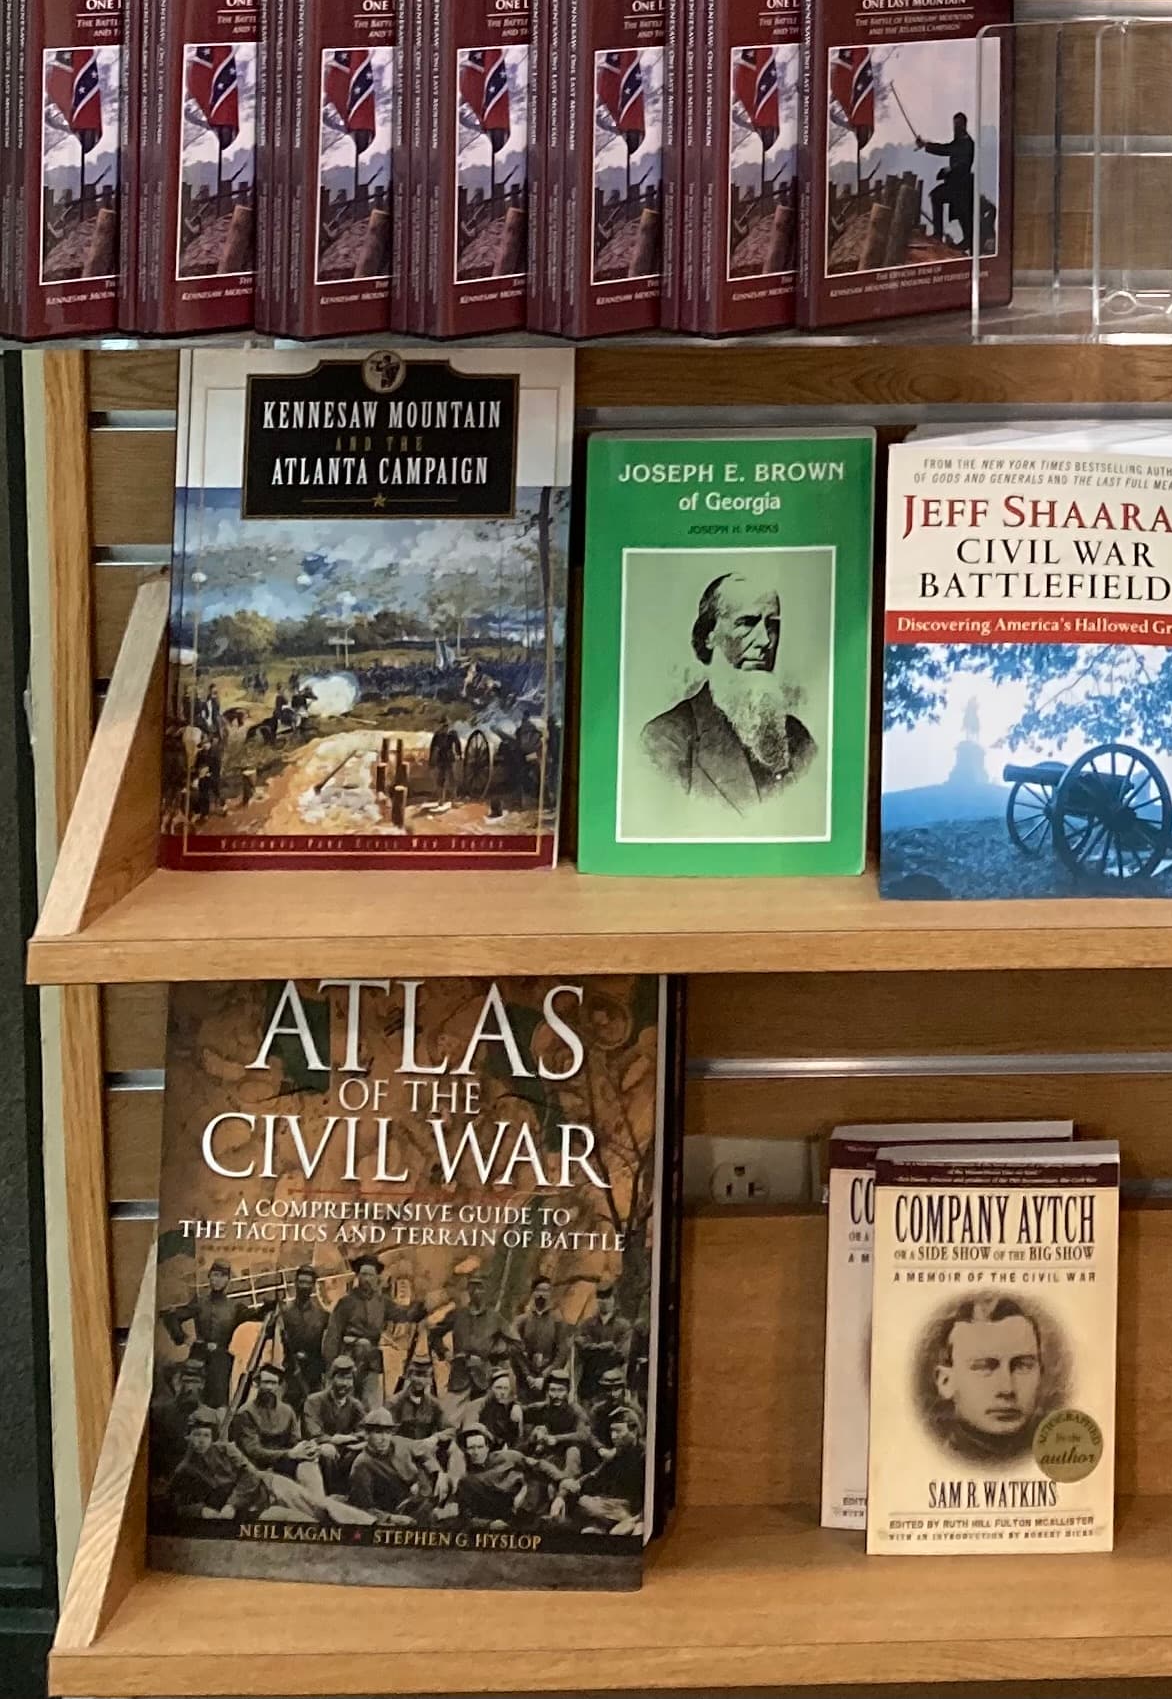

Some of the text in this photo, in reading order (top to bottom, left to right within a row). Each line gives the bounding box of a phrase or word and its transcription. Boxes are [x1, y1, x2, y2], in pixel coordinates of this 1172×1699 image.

[863, 0, 884, 9] ONE
[263, 401, 501, 429] KENNESAW MOUNTAIN
[272, 457, 488, 485] ATLANTA CAMPAIGN
[619, 462, 844, 482] JOSEPH E. BROWN
[679, 492, 781, 515] of Georgia
[902, 495, 989, 539] JEFF
[957, 539, 1155, 567] CIVIL WAR
[897, 617, 992, 635] Discovering
[994, 619, 1071, 633] America's
[1075, 619, 1149, 634] Hallowed
[245, 979, 585, 1081] ATLAS
[339, 1079, 481, 1114] OF THE
[202, 1112, 612, 1189] CIVIL WAR
[895, 1195, 1096, 1244] COMPANY AYTCH
[929, 1480, 1057, 1508] SAM R. WATKINS
